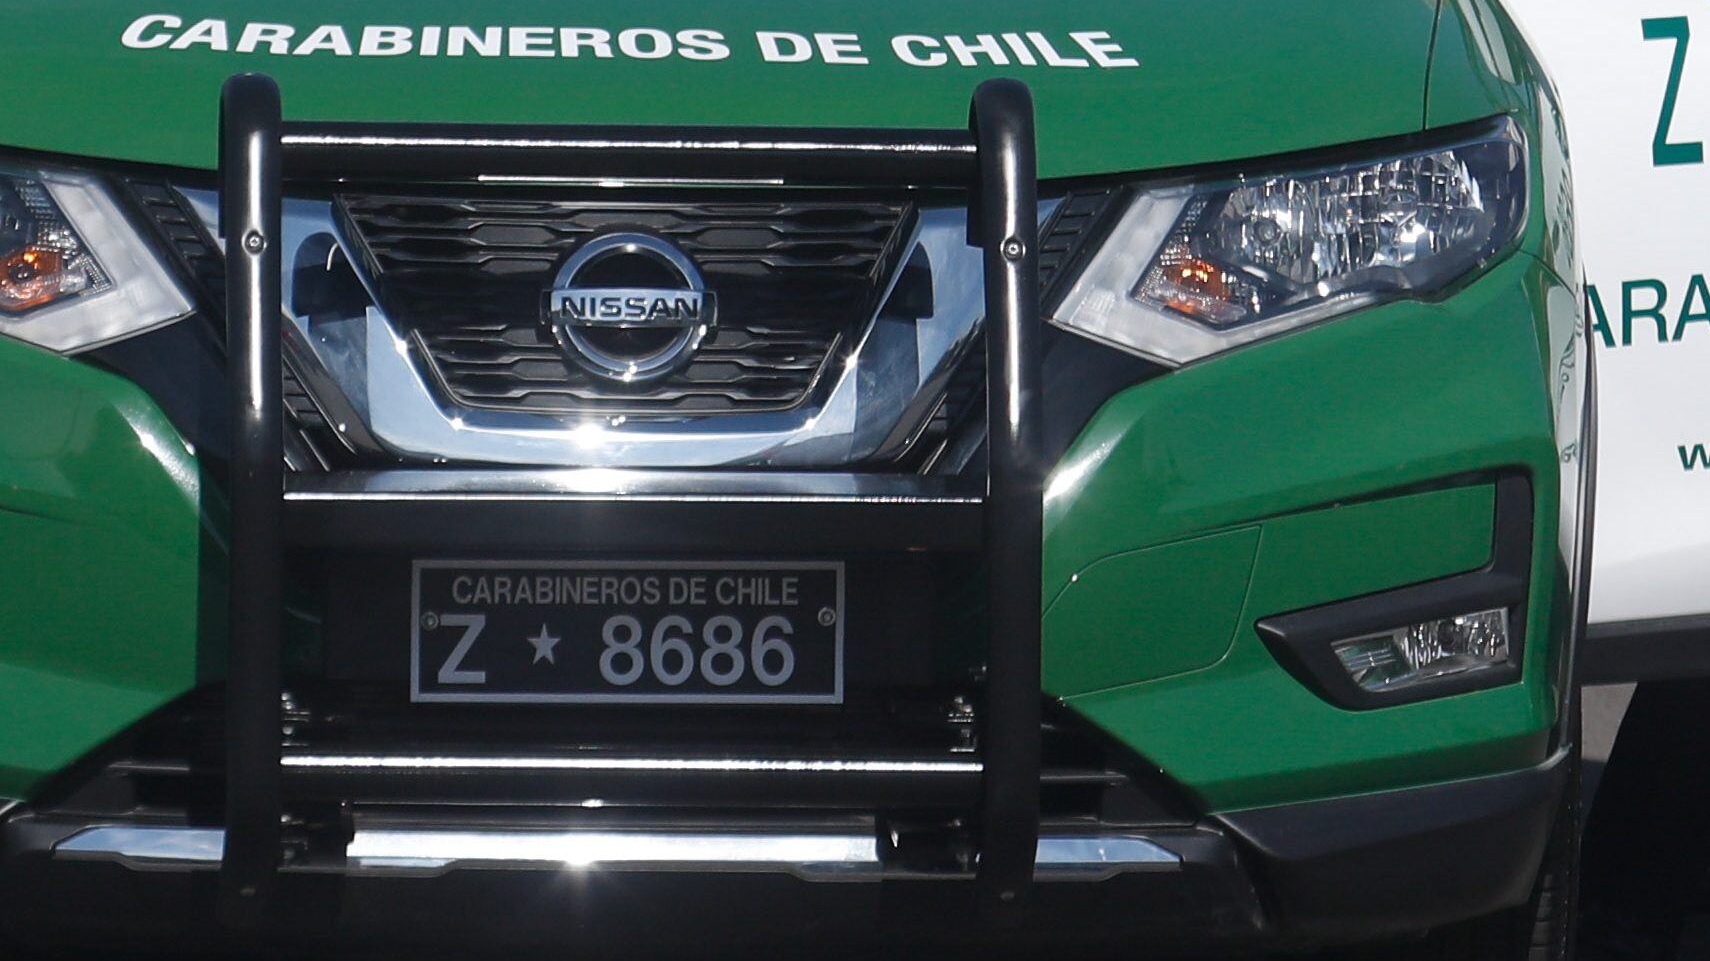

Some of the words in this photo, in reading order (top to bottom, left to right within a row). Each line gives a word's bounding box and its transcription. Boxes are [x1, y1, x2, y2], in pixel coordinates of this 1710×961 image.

[121, 14, 732, 63] CARABINEROS
[755, 31, 870, 65] DE
[891, 31, 1140, 69] CHILE
[1641, 16, 1704, 167] Z
[560, 296, 701, 319] NISSAN
[452, 576, 661, 605] CARABINEROS
[669, 578, 707, 605] DE
[715, 578, 799, 606] CHILE
[437, 614, 487, 684] Z
[599, 615, 796, 686] 8686
